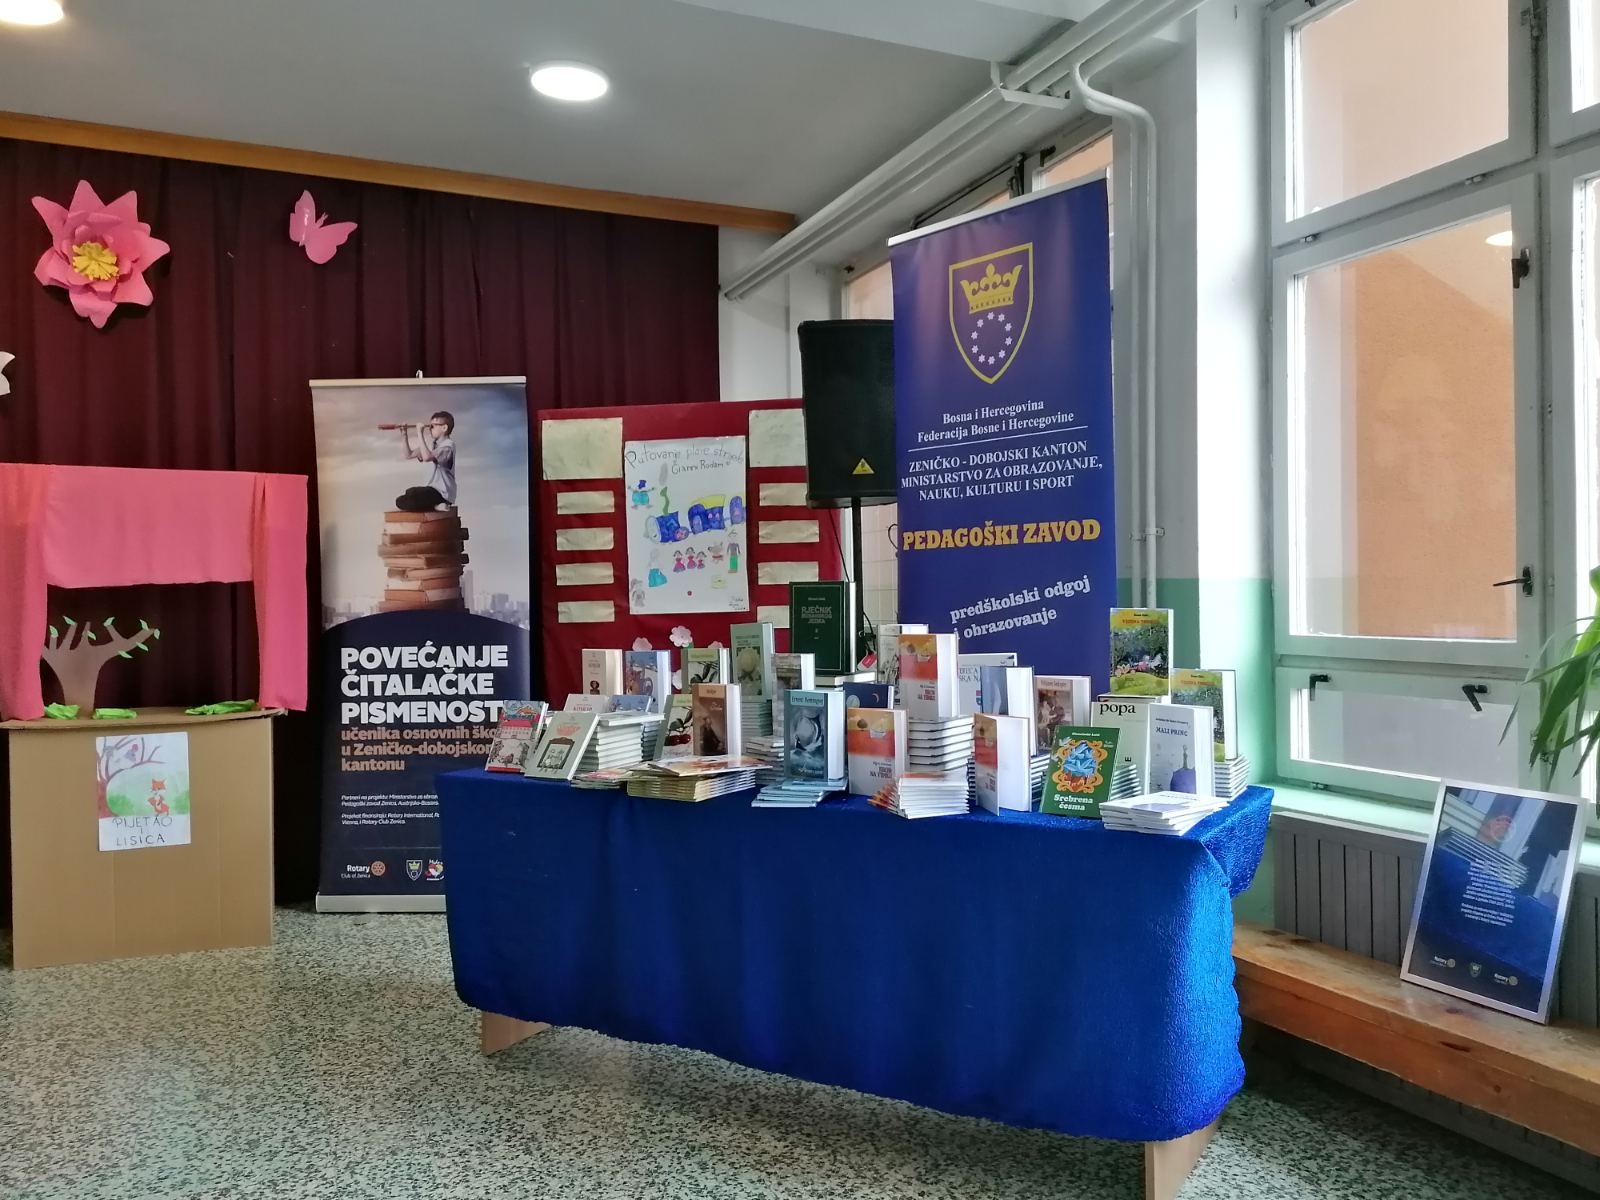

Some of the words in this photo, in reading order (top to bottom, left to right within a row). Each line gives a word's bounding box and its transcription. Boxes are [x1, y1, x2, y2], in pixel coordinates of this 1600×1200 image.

[943, 411, 972, 424] Bosna
[975, 409, 979, 419] i
[981, 400, 1044, 418] Hercegovina
[918, 427, 968, 442] Federacija
[971, 423, 1000, 436] Bosne
[1002, 420, 1006, 431] i
[1009, 411, 1074, 430] Hercegovine
[909, 455, 960, 473] ZENIČKO
[969, 447, 1029, 466] DOBOJSKI
[1032, 440, 1087, 459] KANTON
[901, 469, 983, 488] MINISTARSTVO
[985, 466, 1002, 480] ZA
[1003, 456, 1103, 477] OBRAZOVANJE,
[919, 486, 964, 502] NAUKU,
[966, 480, 1022, 498] KULTURU
[1025, 480, 1030, 491] I
[1032, 475, 1075, 490] SPORT
[902, 520, 1019, 551] PEDAGOŠKI
[1023, 518, 1101, 544] ZAVOD
[950, 587, 1041, 624] predškolski
[1044, 574, 1091, 599] odgoj
[963, 607, 1057, 640] obrazovanje
[340, 640, 508, 670] POVEĆANJE
[340, 667, 495, 697] ČITALAČKE
[341, 700, 504, 725] PISMENOST
[1099, 702, 1136, 716] popa
[341, 726, 400, 741] učenika
[402, 725, 470, 740] osnovnih
[472, 725, 498, 739] ško
[341, 745, 351, 756] u
[341, 758, 405, 772] kantonu
[1053, 794, 1094, 804] Srebrena
[113, 816, 173, 829] PIJETAO
[116, 833, 166, 847] LISICA
[346, 864, 371, 873] Rotary
